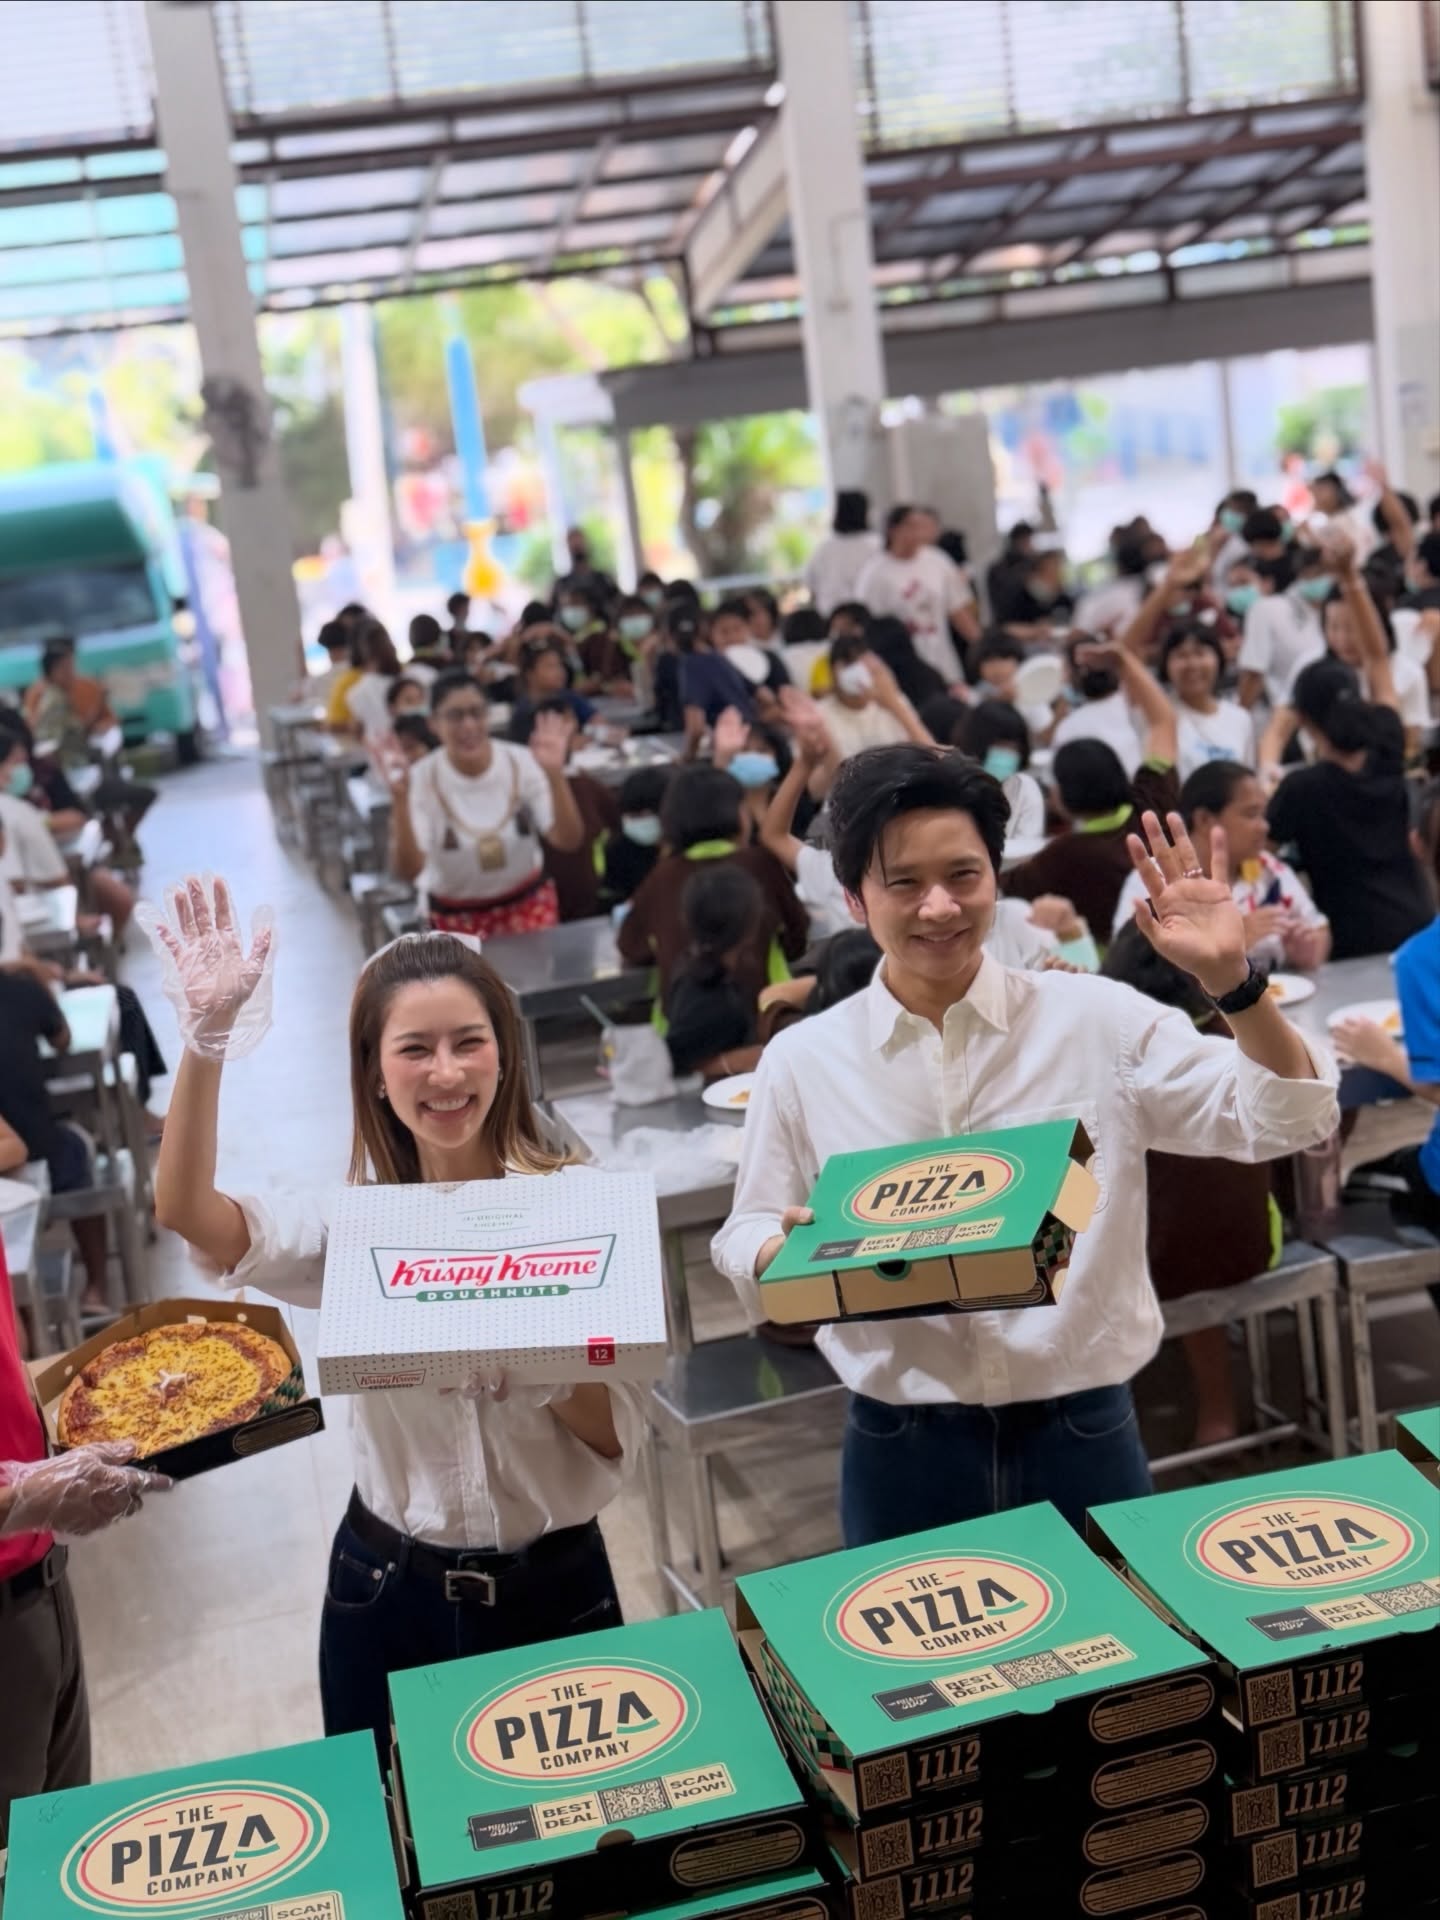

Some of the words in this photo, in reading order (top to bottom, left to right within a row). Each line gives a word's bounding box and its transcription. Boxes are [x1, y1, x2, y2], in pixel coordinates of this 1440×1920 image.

[928, 1163, 952, 1175] THE
[869, 1170, 986, 1210] PIZZA
[890, 1201, 957, 1217] COMPANY
[865, 1236, 901, 1246] BEST
[954, 1229, 995, 1239] NOW!
[390, 1256, 498, 1286] Krispy
[497, 1249, 602, 1281] Kreme
[426, 1286, 559, 1301] DOUGHNUTS
[594, 1348, 609, 1360] 12
[1260, 1511, 1299, 1529] THE
[1218, 1518, 1390, 1575] PIZZA
[1286, 1555, 1374, 1582] COMPANY
[905, 1572, 943, 1591] THE
[859, 1576, 1029, 1646] PIZZA
[1319, 1600, 1368, 1617] BEST
[1328, 1609, 1381, 1624] DEAL
[920, 1619, 1009, 1652] COMPANY
[1064, 1640, 1117, 1659] SCAN
[1073, 1648, 1125, 1667] NOW!
[944, 1672, 993, 1691] BEST
[952, 1682, 1005, 1699] DEAL
[1300, 1659, 1365, 1705] 1112
[551, 1683, 587, 1702] THE
[494, 1690, 661, 1760] PIZZA
[1309, 1709, 1371, 1755] 1112
[540, 1739, 630, 1771] COMPANY
[915, 1739, 982, 1788] 1112
[670, 1771, 723, 1789] SCAN
[674, 1781, 727, 1800] NOW!
[1284, 1774, 1348, 1817] 1112
[176, 1804, 214, 1826] THE
[542, 1800, 593, 1818] BEST
[545, 1812, 599, 1830] DEAL
[919, 1806, 984, 1854] 1112
[111, 1813, 281, 1885] PIZZA
[1302, 1821, 1363, 1866] 1112
[146, 1863, 248, 1896] COMPANY
[909, 1863, 975, 1910] 1112
[485, 1880, 555, 1920] 1112
[1305, 1879, 1366, 1920] 1112
[277, 1901, 331, 1919] SCAN
